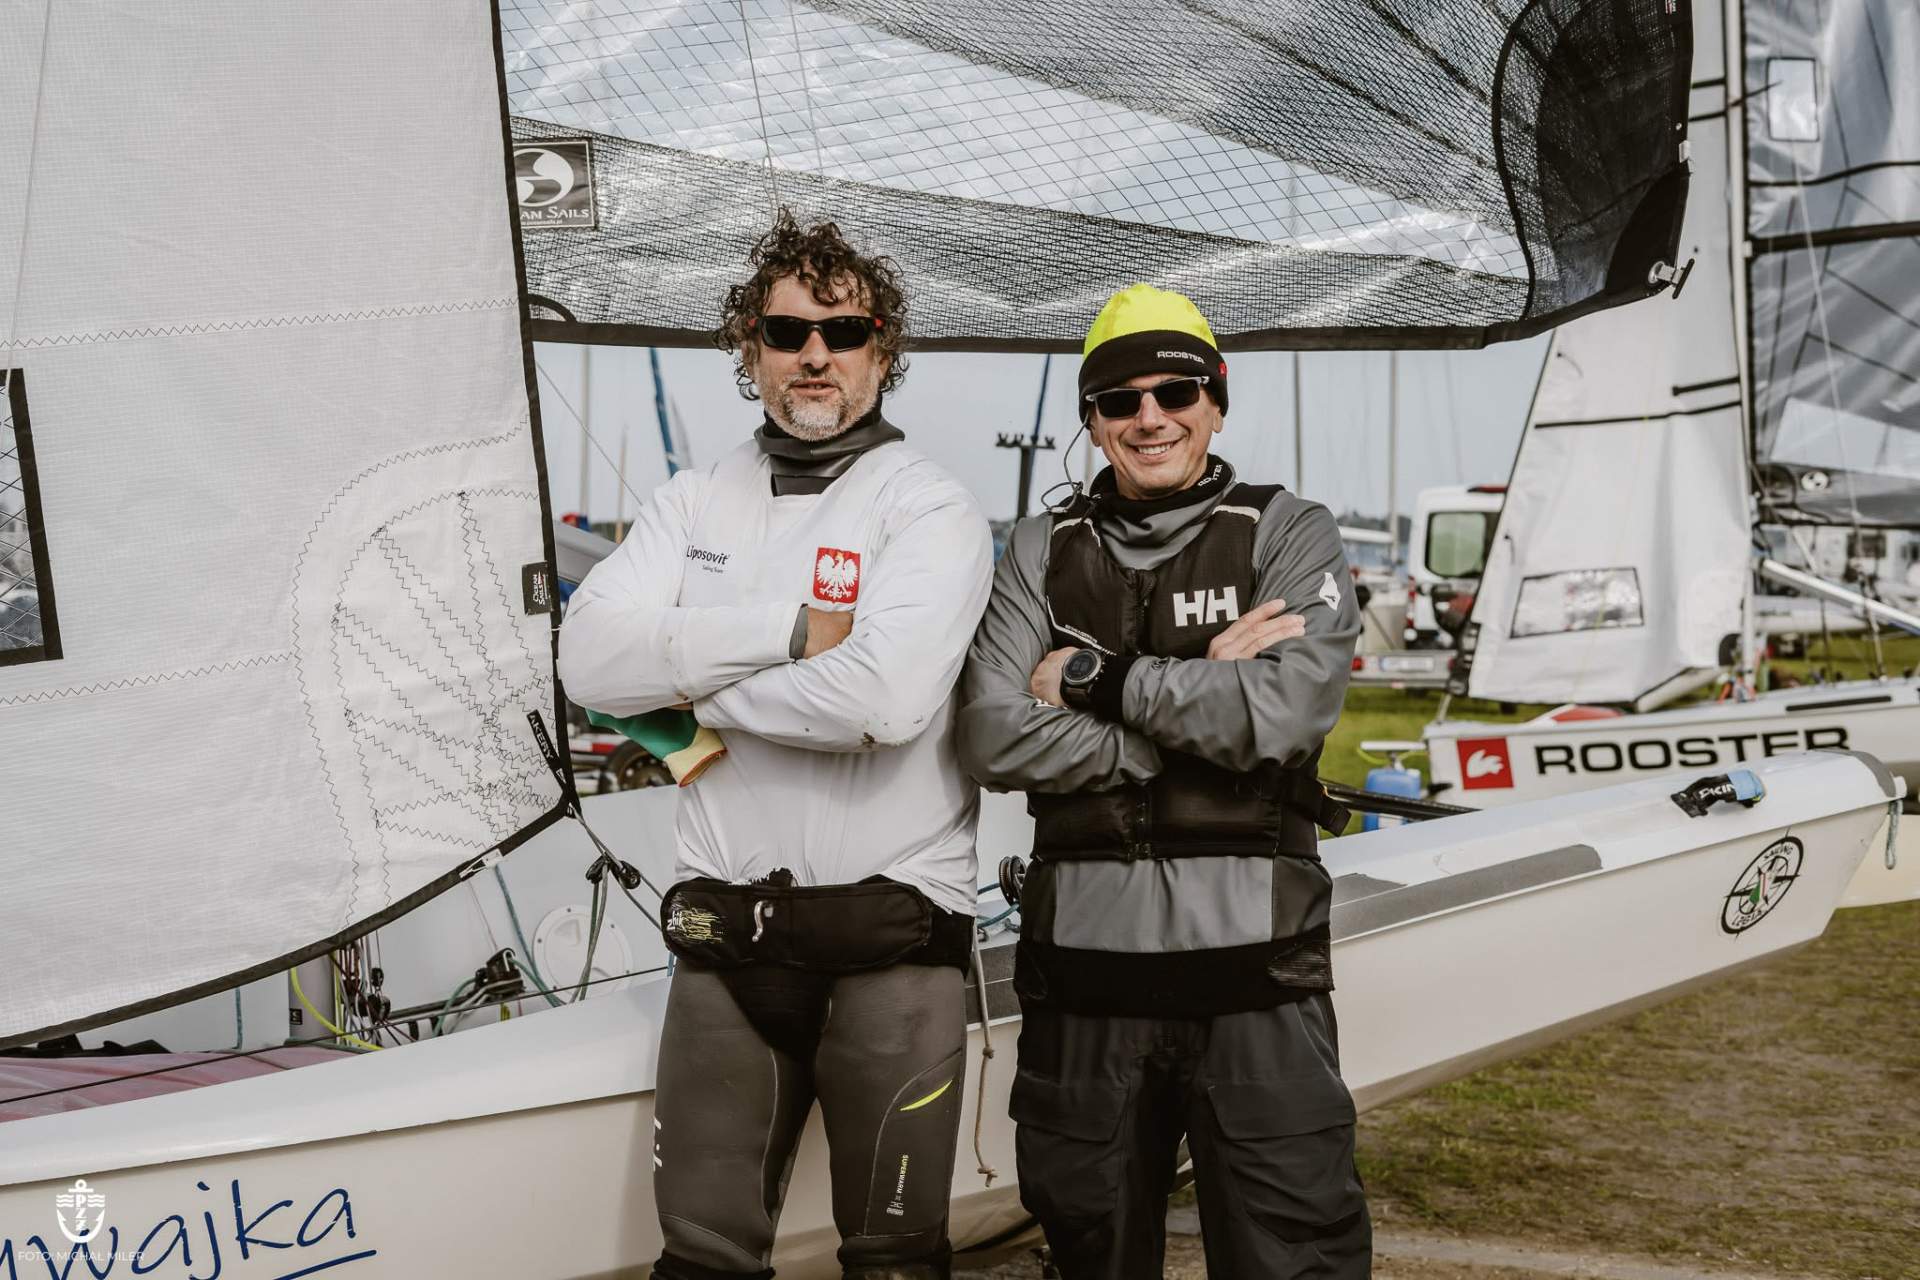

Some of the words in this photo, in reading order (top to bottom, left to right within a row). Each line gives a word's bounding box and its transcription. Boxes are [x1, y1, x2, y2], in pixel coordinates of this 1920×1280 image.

[520, 210, 543, 221] AN
[1157, 350, 1206, 364] ROOSTER
[686, 544, 729, 565] Liposovit
[1173, 586, 1240, 627] HH
[1534, 727, 1850, 775] ROOSTER
[896, 1154, 909, 1194] SUPERWARM
